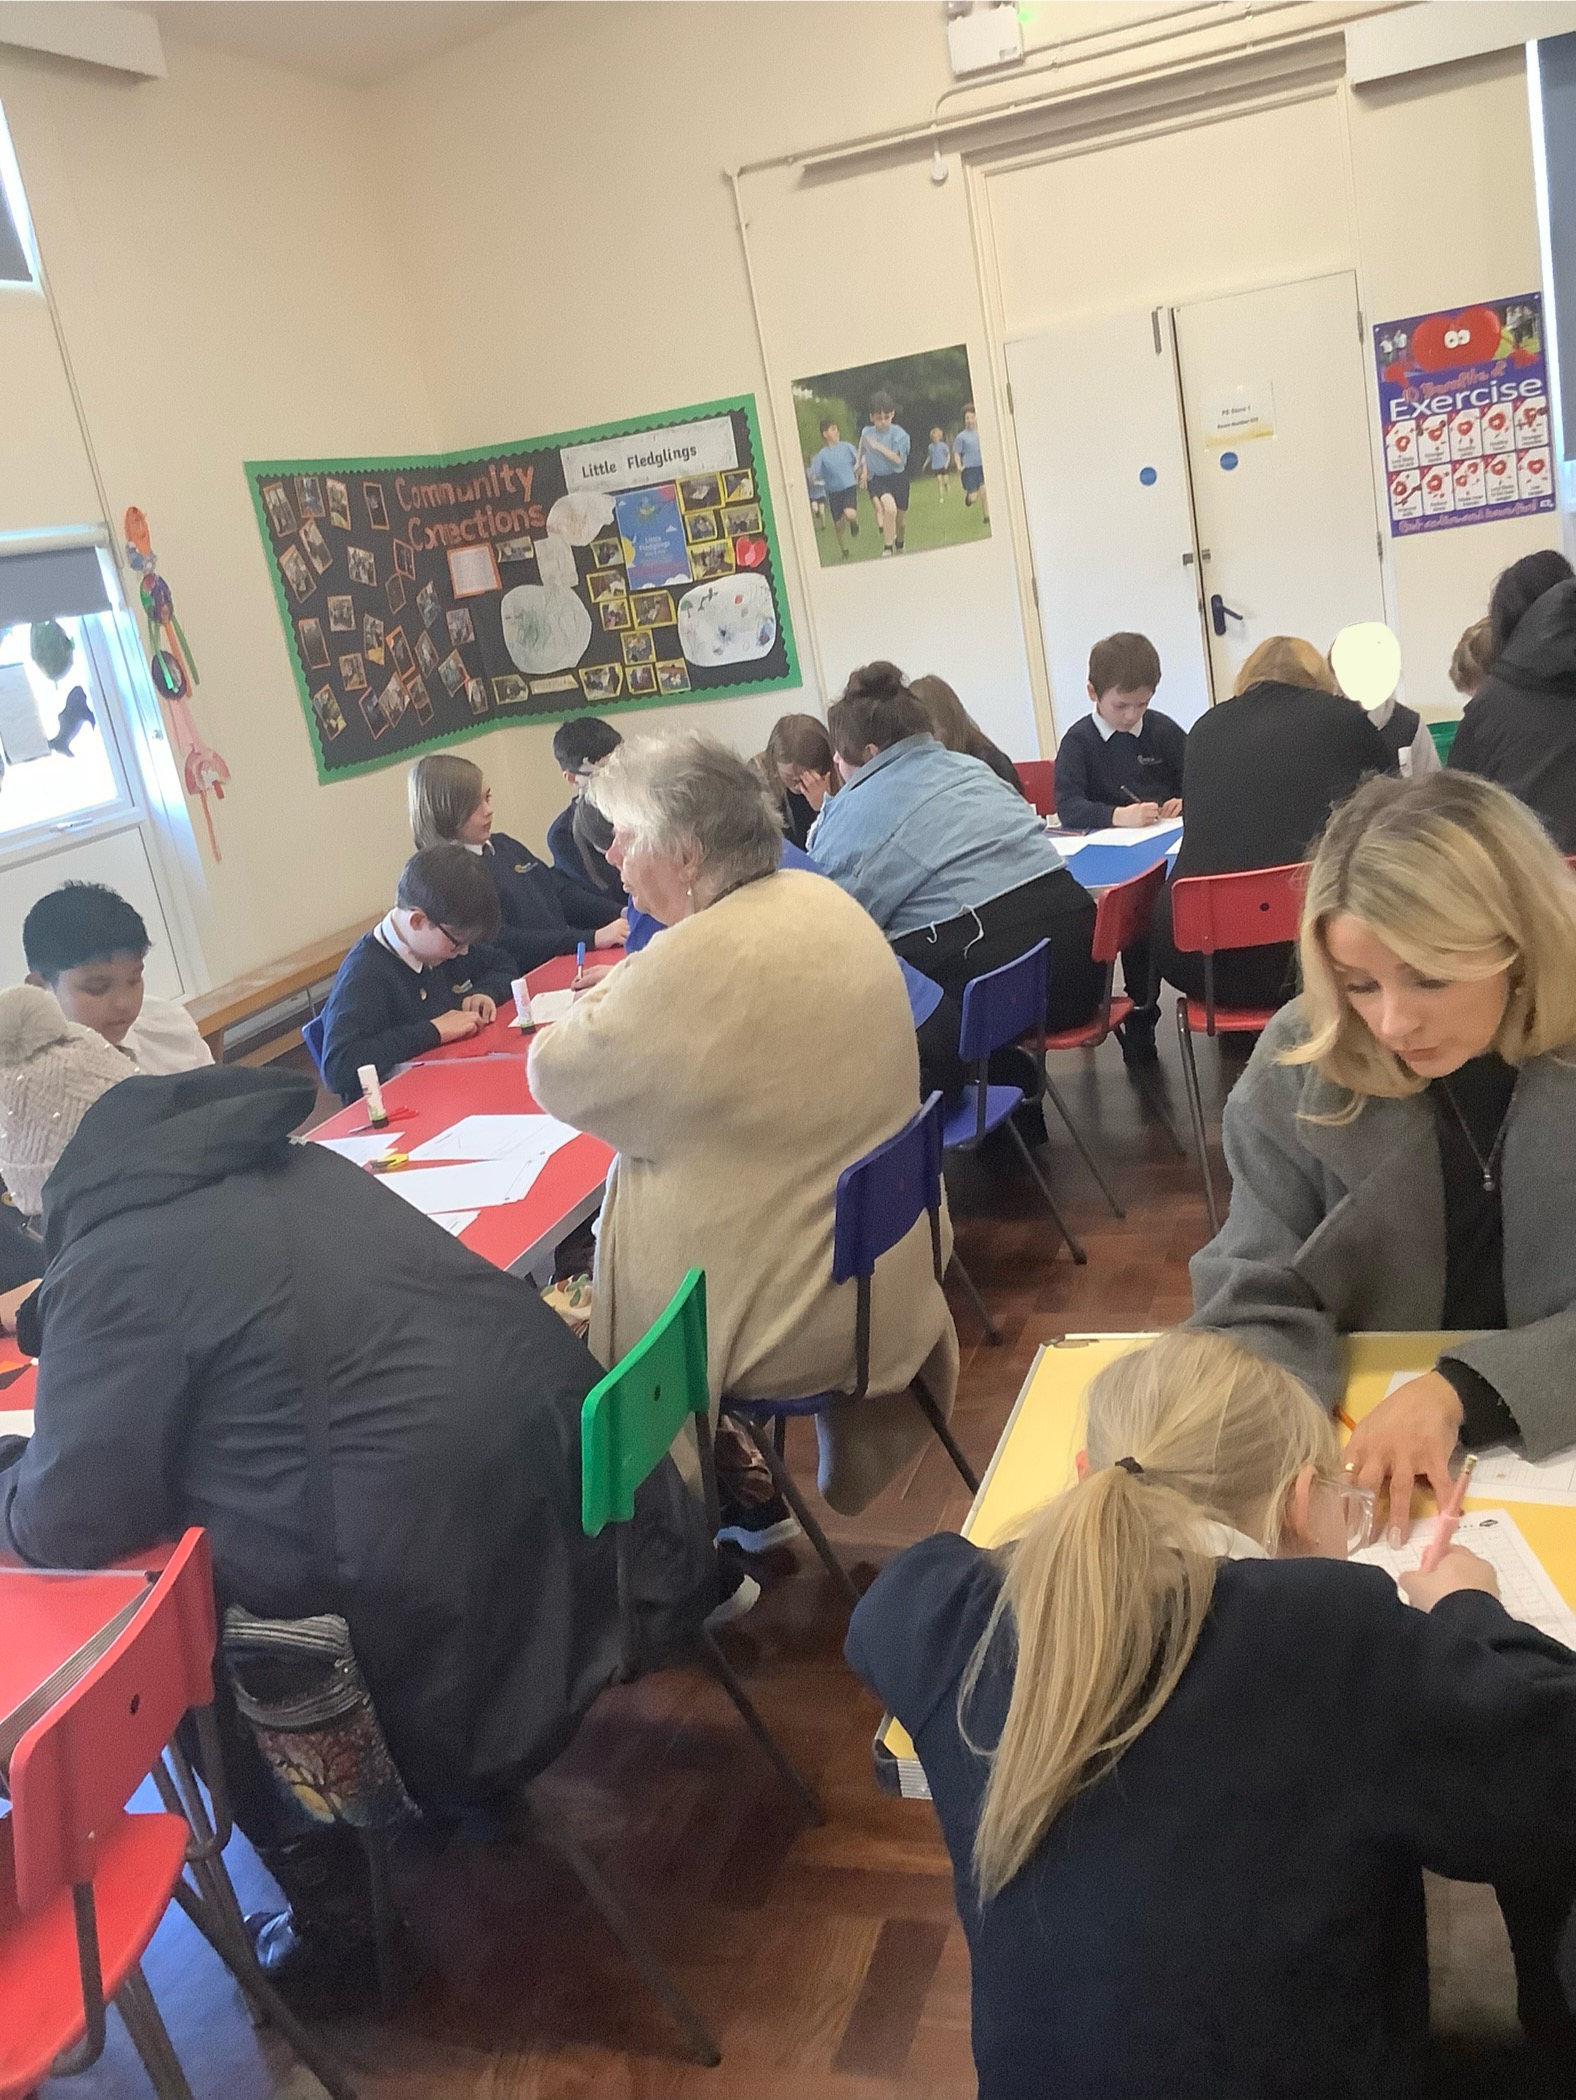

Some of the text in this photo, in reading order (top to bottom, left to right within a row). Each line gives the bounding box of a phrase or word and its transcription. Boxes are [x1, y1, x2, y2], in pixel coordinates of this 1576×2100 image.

[1389, 377, 1543, 422] Exercise
[581, 445, 698, 479] Little Fledglings
[395, 463, 534, 512] Community
